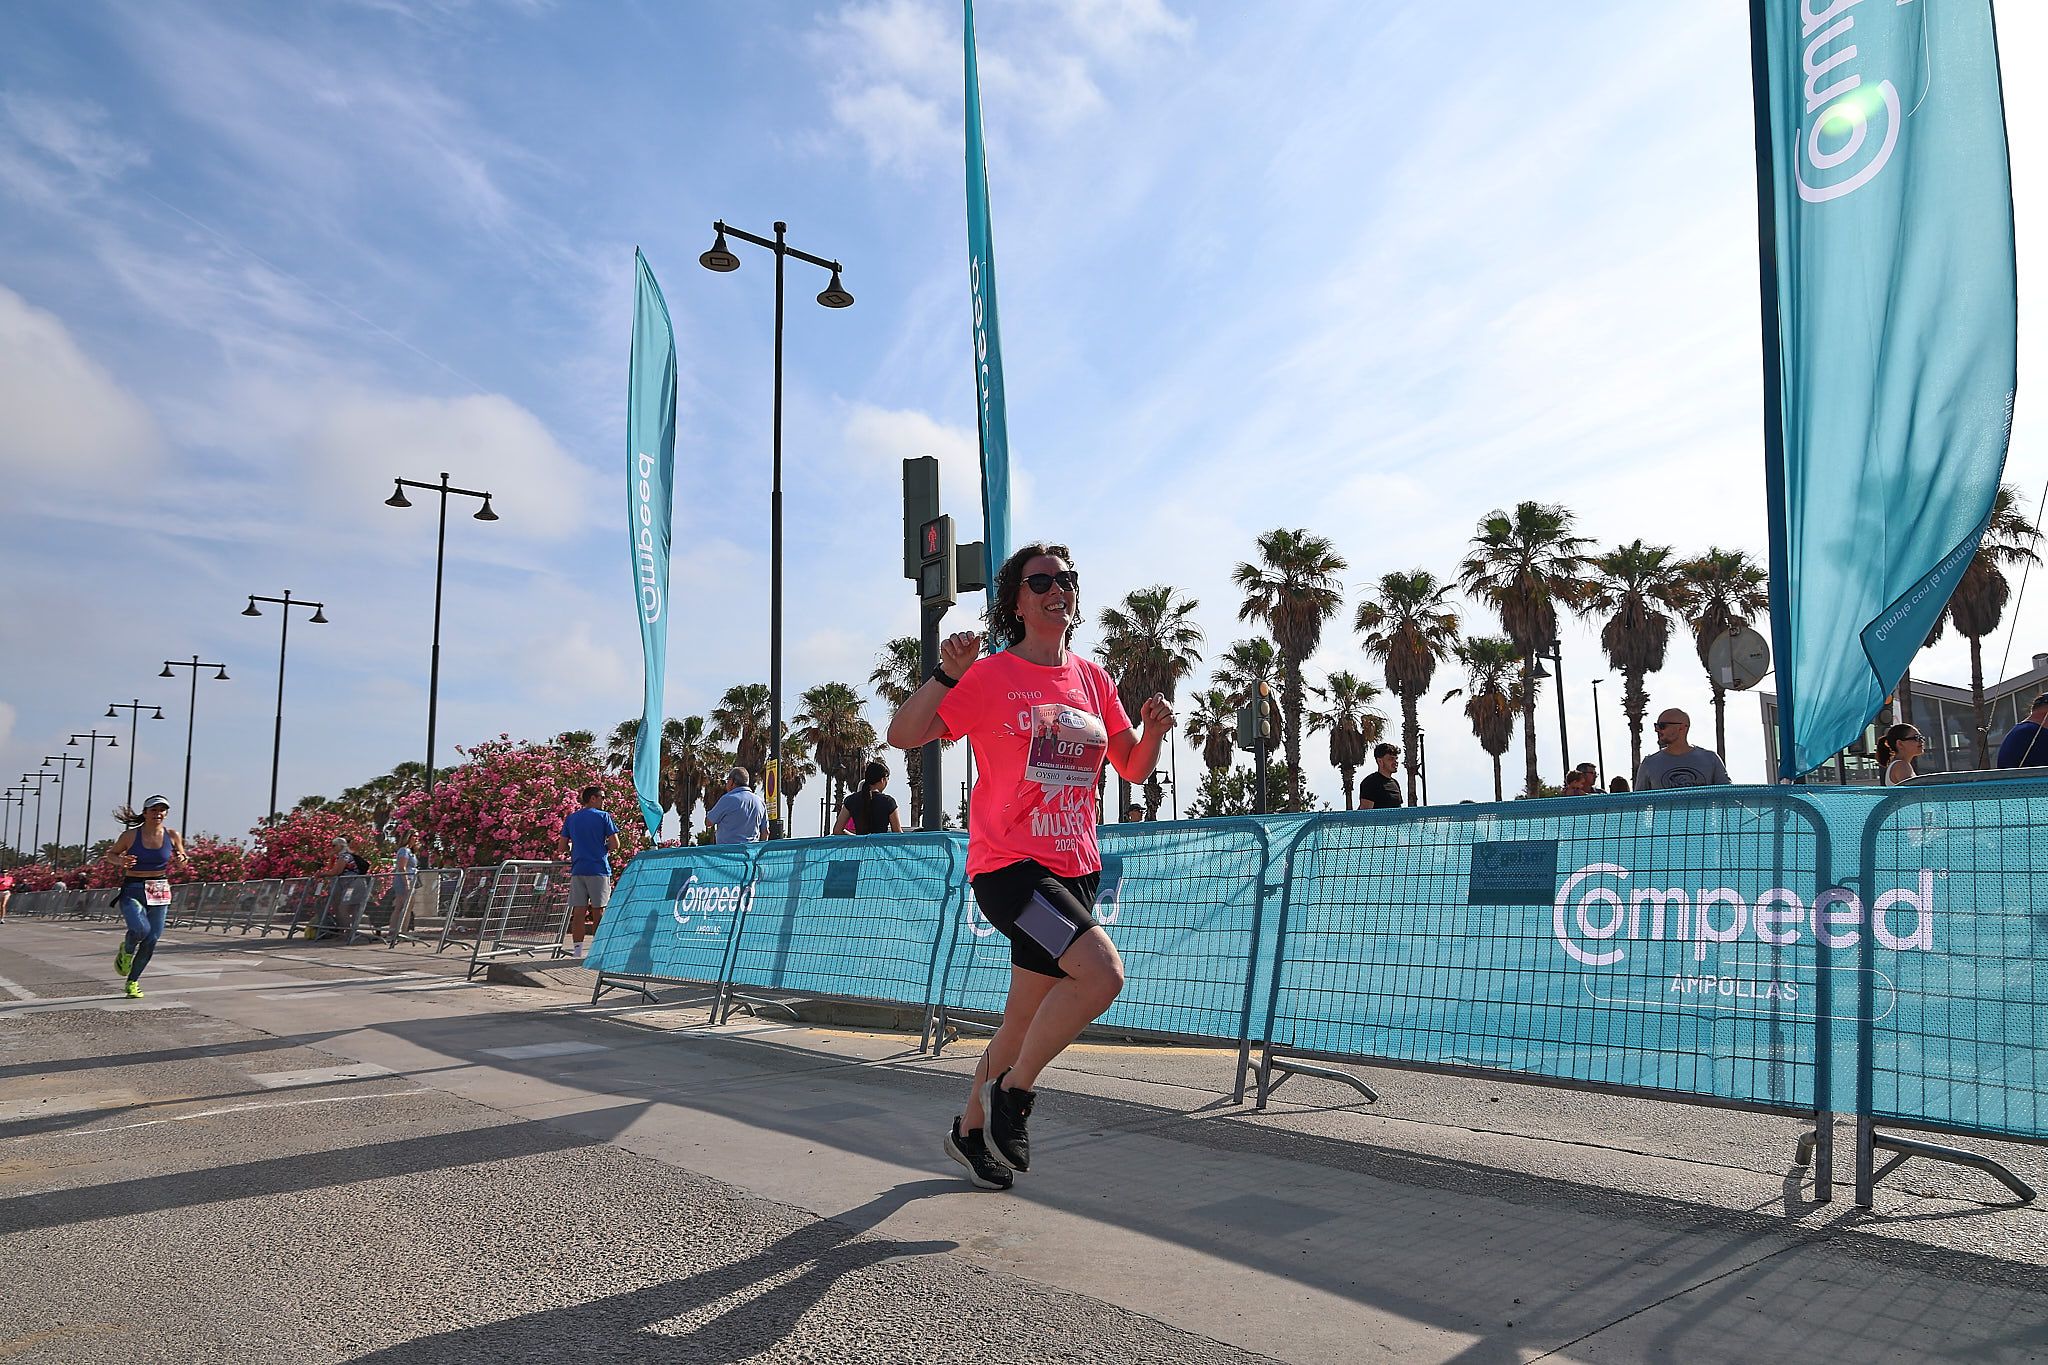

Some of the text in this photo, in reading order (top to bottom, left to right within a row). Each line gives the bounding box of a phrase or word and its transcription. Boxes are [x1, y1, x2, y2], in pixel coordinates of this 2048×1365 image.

[1007, 690, 1042, 700] OYSHO
[1057, 741, 1085, 756] 016
[1031, 811, 1086, 837] MUJER
[1055, 838, 1076, 852] 2026
[673, 875, 756, 924] Compeed
[1553, 862, 1933, 965] Compeed
[1670, 973, 1800, 1002] AMPOLLAS
